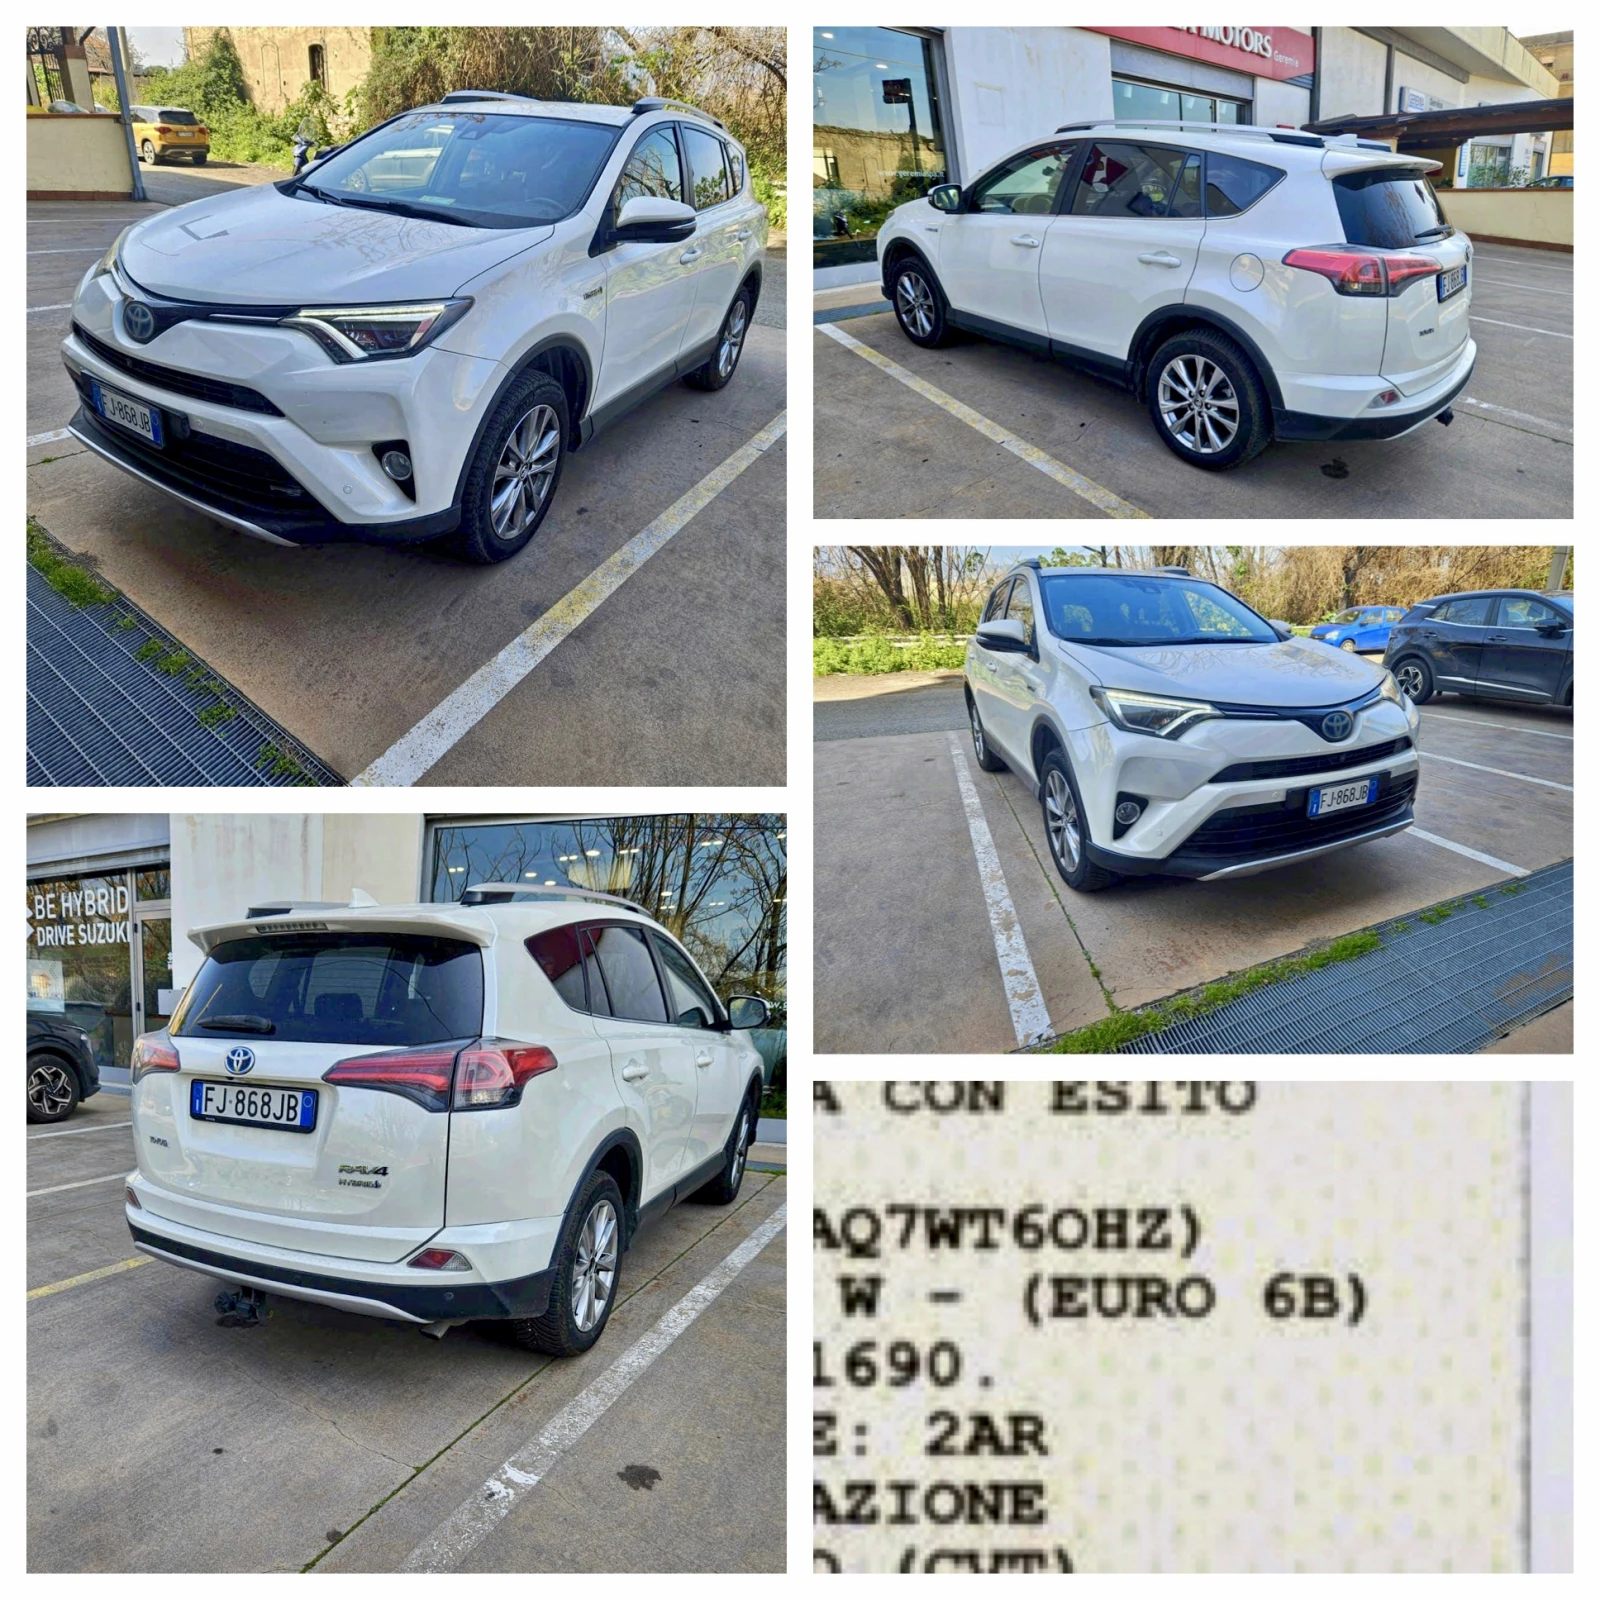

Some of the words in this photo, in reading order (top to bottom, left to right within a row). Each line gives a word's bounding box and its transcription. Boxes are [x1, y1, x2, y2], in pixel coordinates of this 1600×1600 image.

[1200, 26, 1272, 58] MOTORS
[1273, 51, 1299, 67] Geremia
[34, 894, 56, 920] BE
[61, 886, 129, 918] HYBRID
[37, 924, 75, 946] DRIVE
[78, 921, 131, 945] SUZUKI
[884, 1081, 1004, 1113] CON
[1048, 1081, 1258, 1114] ESITO
[338, 1164, 389, 1177] RAV4
[837, 1273, 885, 1317] W
[1023, 1272, 1217, 1327] (EURO
[1263, 1272, 1368, 1327] 6B)
[925, 1410, 1050, 1457] 2AR
[813, 1480, 1048, 1525] AZIONE
